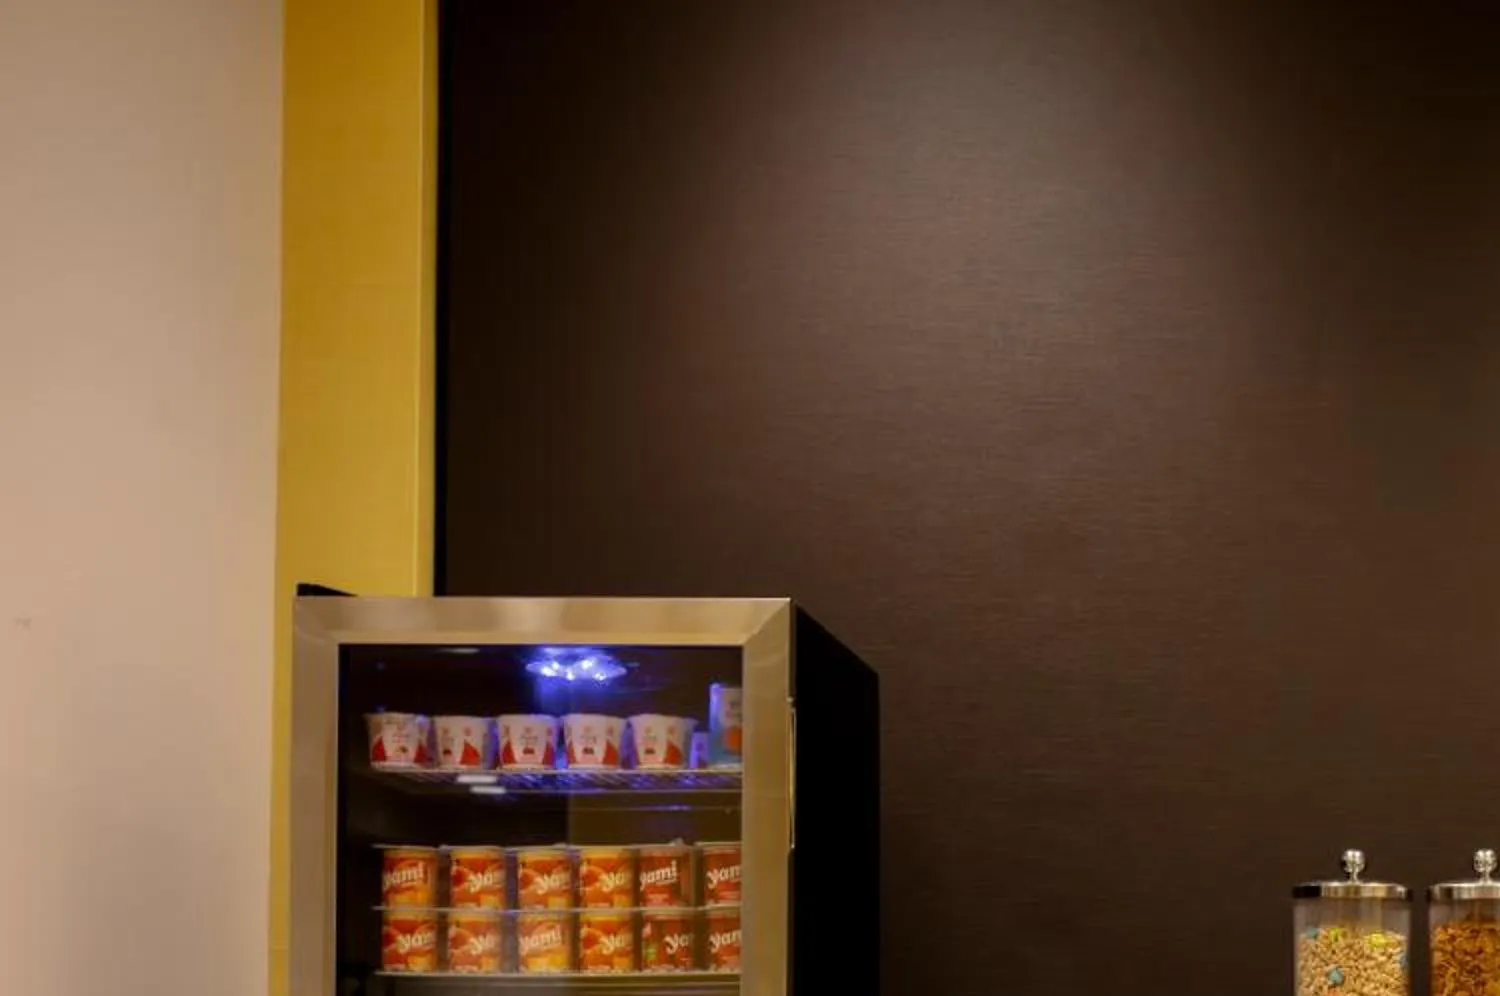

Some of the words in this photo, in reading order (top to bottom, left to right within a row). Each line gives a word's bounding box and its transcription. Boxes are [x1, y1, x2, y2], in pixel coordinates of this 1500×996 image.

[468, 870, 505, 893] ya
[534, 871, 570, 895] ya
[639, 860, 678, 892] yami
[706, 865, 741, 889] yam
[397, 931, 435, 953] yam
[468, 933, 499, 955] ya
[664, 932, 694, 955] ya
[709, 930, 741, 954] yam
